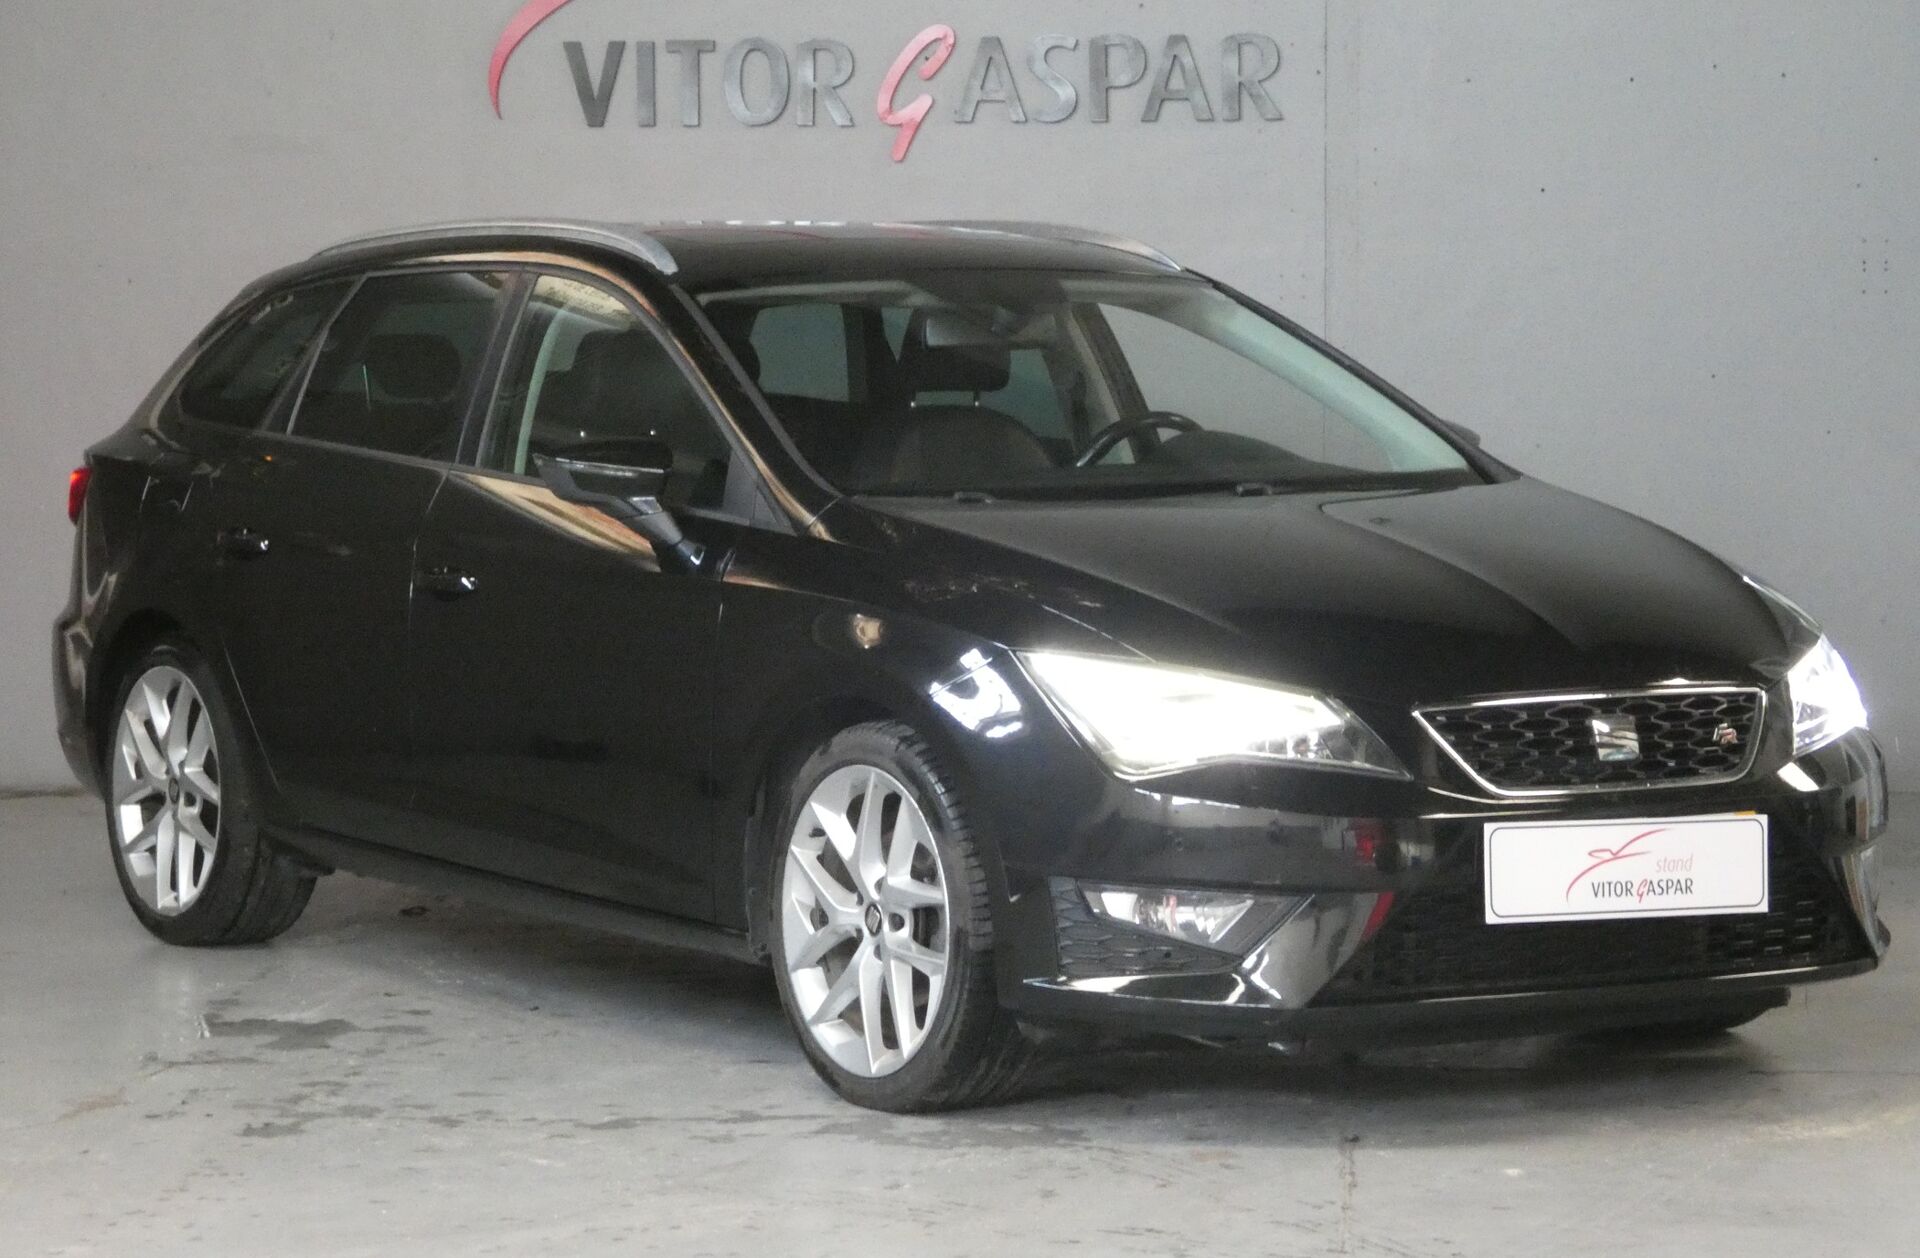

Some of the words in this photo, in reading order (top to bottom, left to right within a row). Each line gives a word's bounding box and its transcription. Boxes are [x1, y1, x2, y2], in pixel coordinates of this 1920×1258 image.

[563, 37, 855, 128] VITOR
[877, 23, 1284, 162] GASPAR
[1655, 853, 1694, 873] stand
[1591, 880, 1634, 898] VITOR
[1636, 878, 1694, 903] GASPAR
